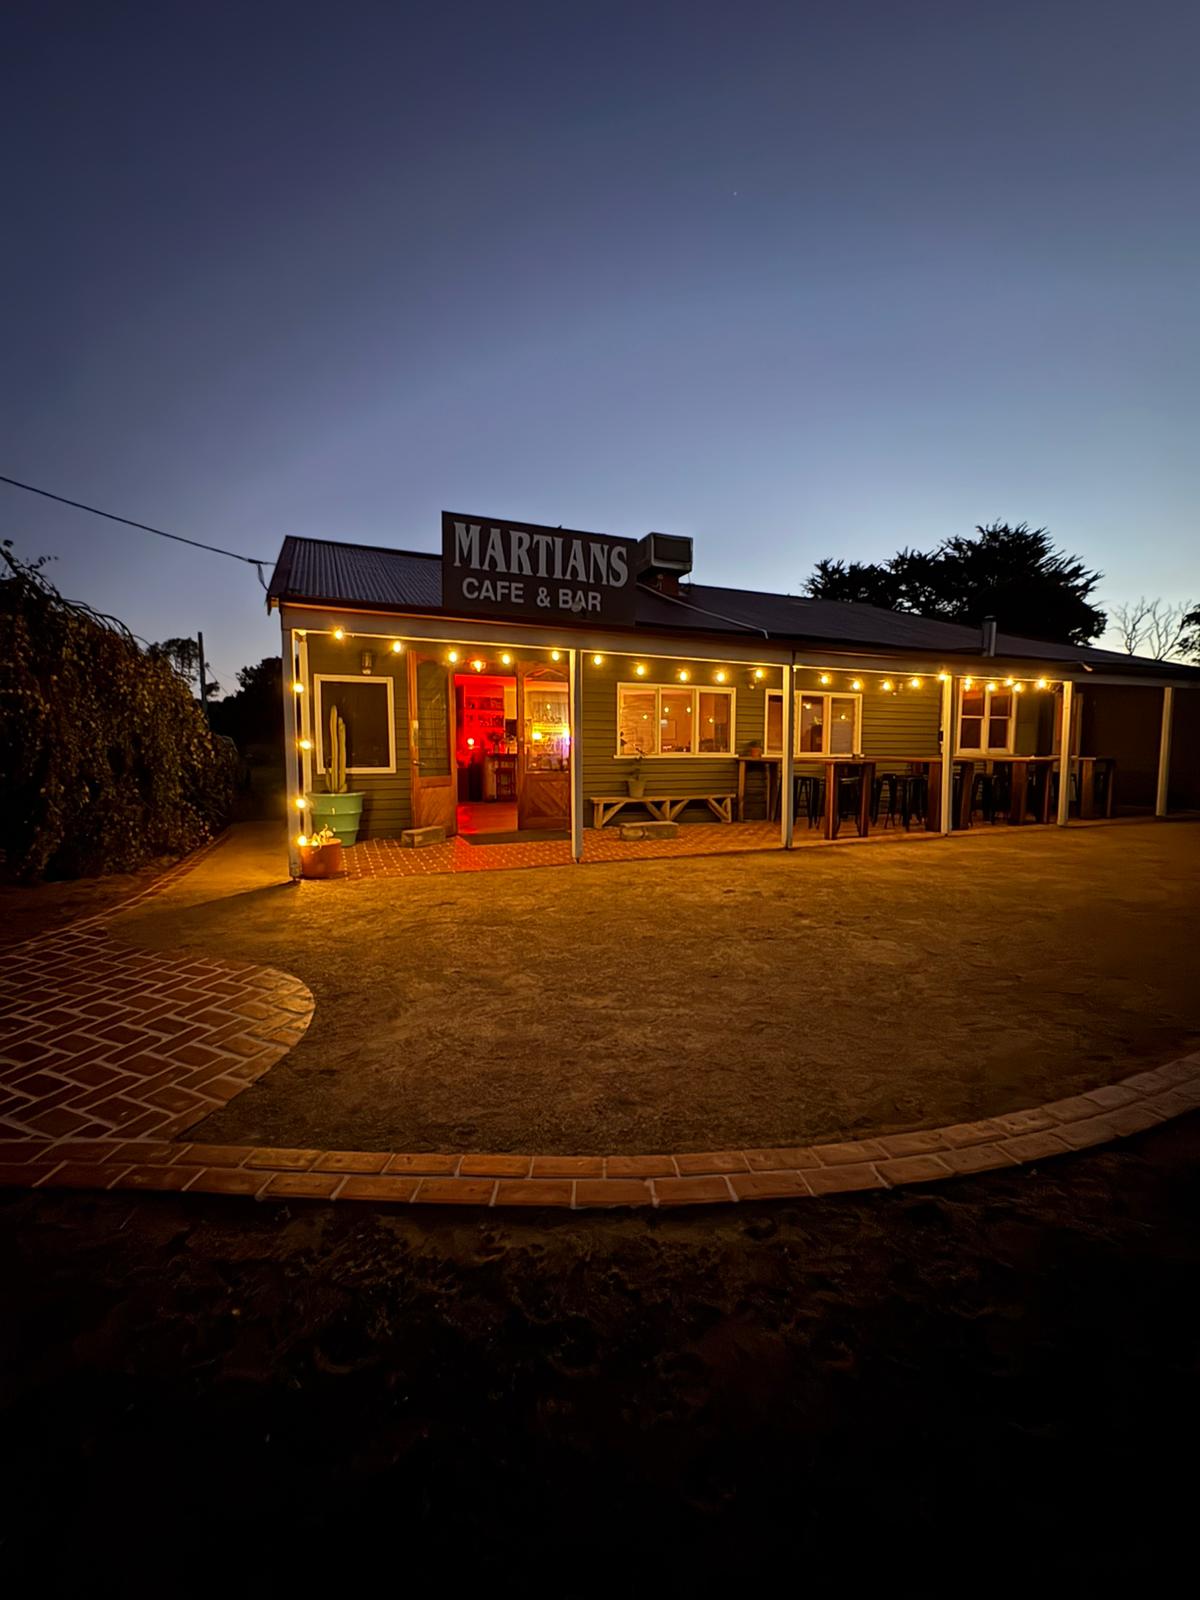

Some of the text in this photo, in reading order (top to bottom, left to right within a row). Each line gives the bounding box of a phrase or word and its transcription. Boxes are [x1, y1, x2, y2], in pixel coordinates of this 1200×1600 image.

[453, 522, 629, 588] MARTIANS
[462, 577, 601, 612] CAFE & BAR
